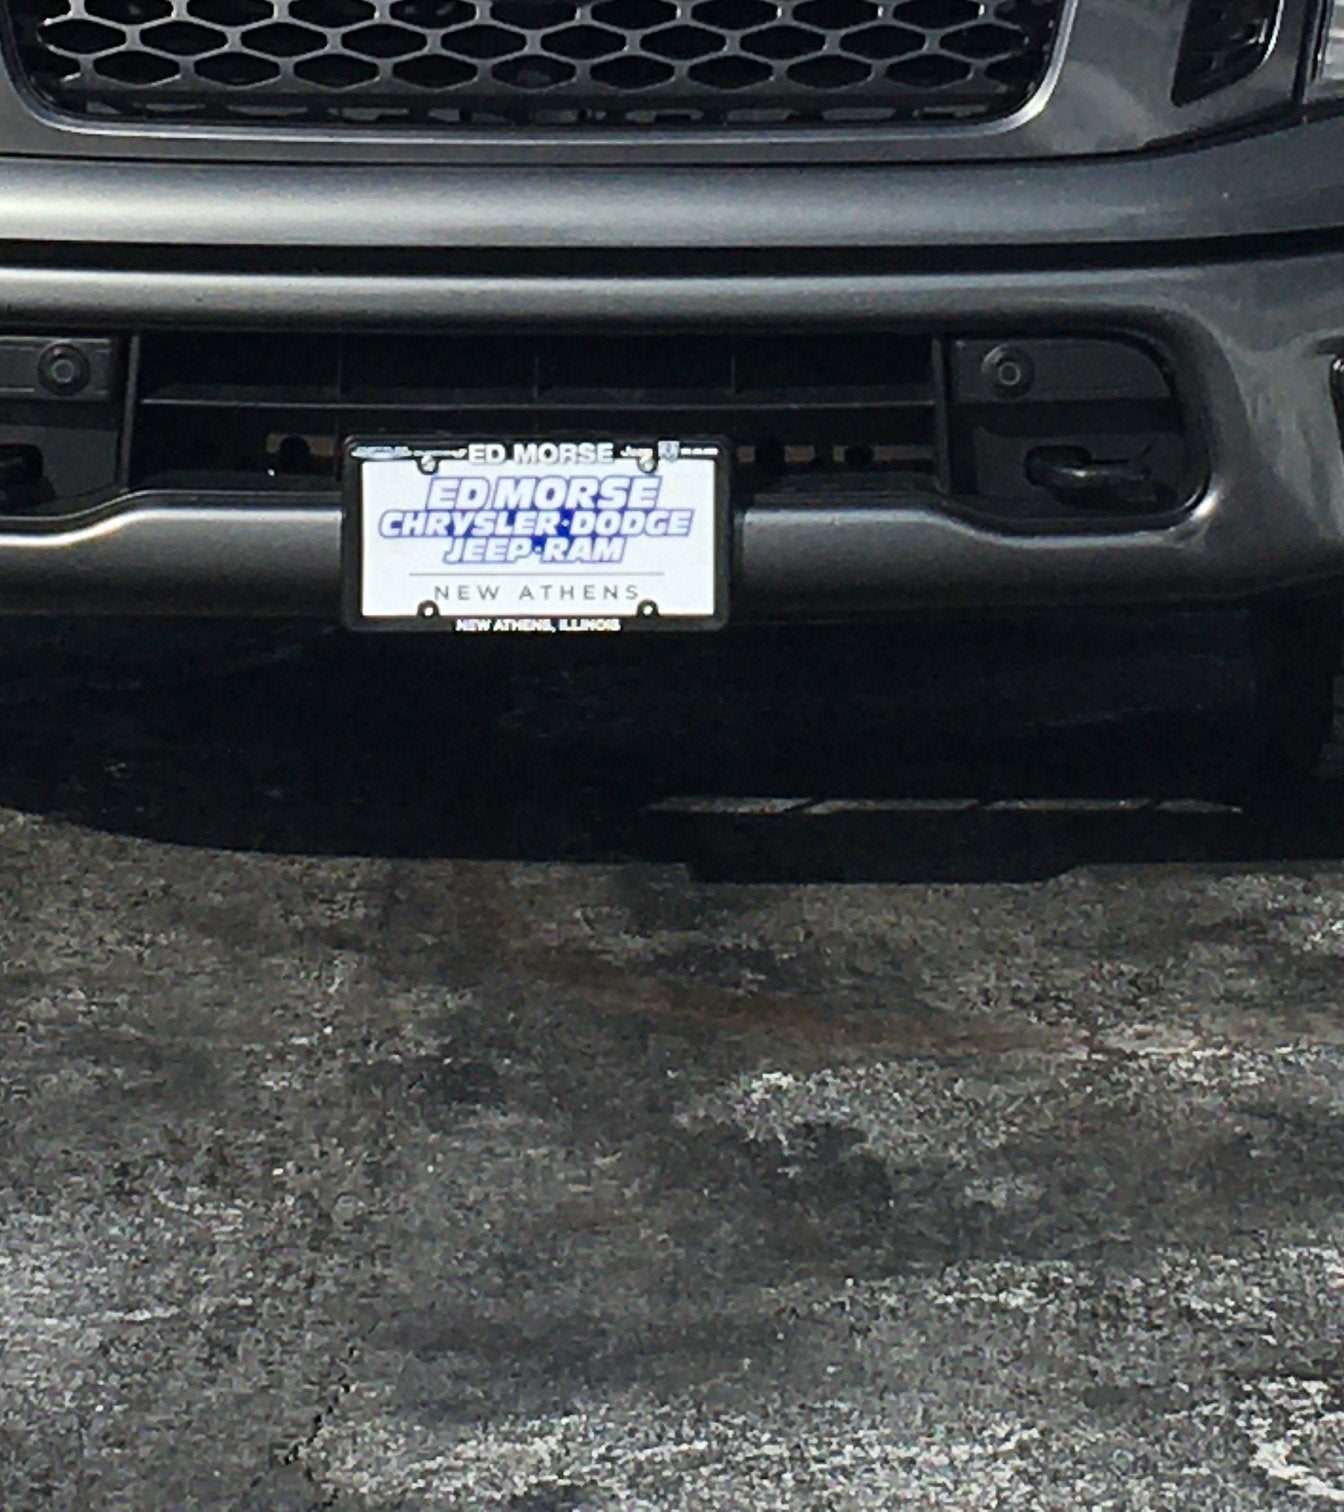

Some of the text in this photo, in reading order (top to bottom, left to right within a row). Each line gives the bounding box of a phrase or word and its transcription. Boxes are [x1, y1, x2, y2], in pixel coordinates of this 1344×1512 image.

[467, 443, 506, 464] ED
[513, 443, 615, 464] MORSE
[426, 475, 663, 510] ED MORSE
[379, 508, 695, 538] CHRYSLER DODGE
[443, 536, 627, 564] JEEP RAM
[433, 584, 639, 601] NEW ATHENS
[456, 618, 492, 631] NEW
[559, 618, 621, 631] ILLINOIS
